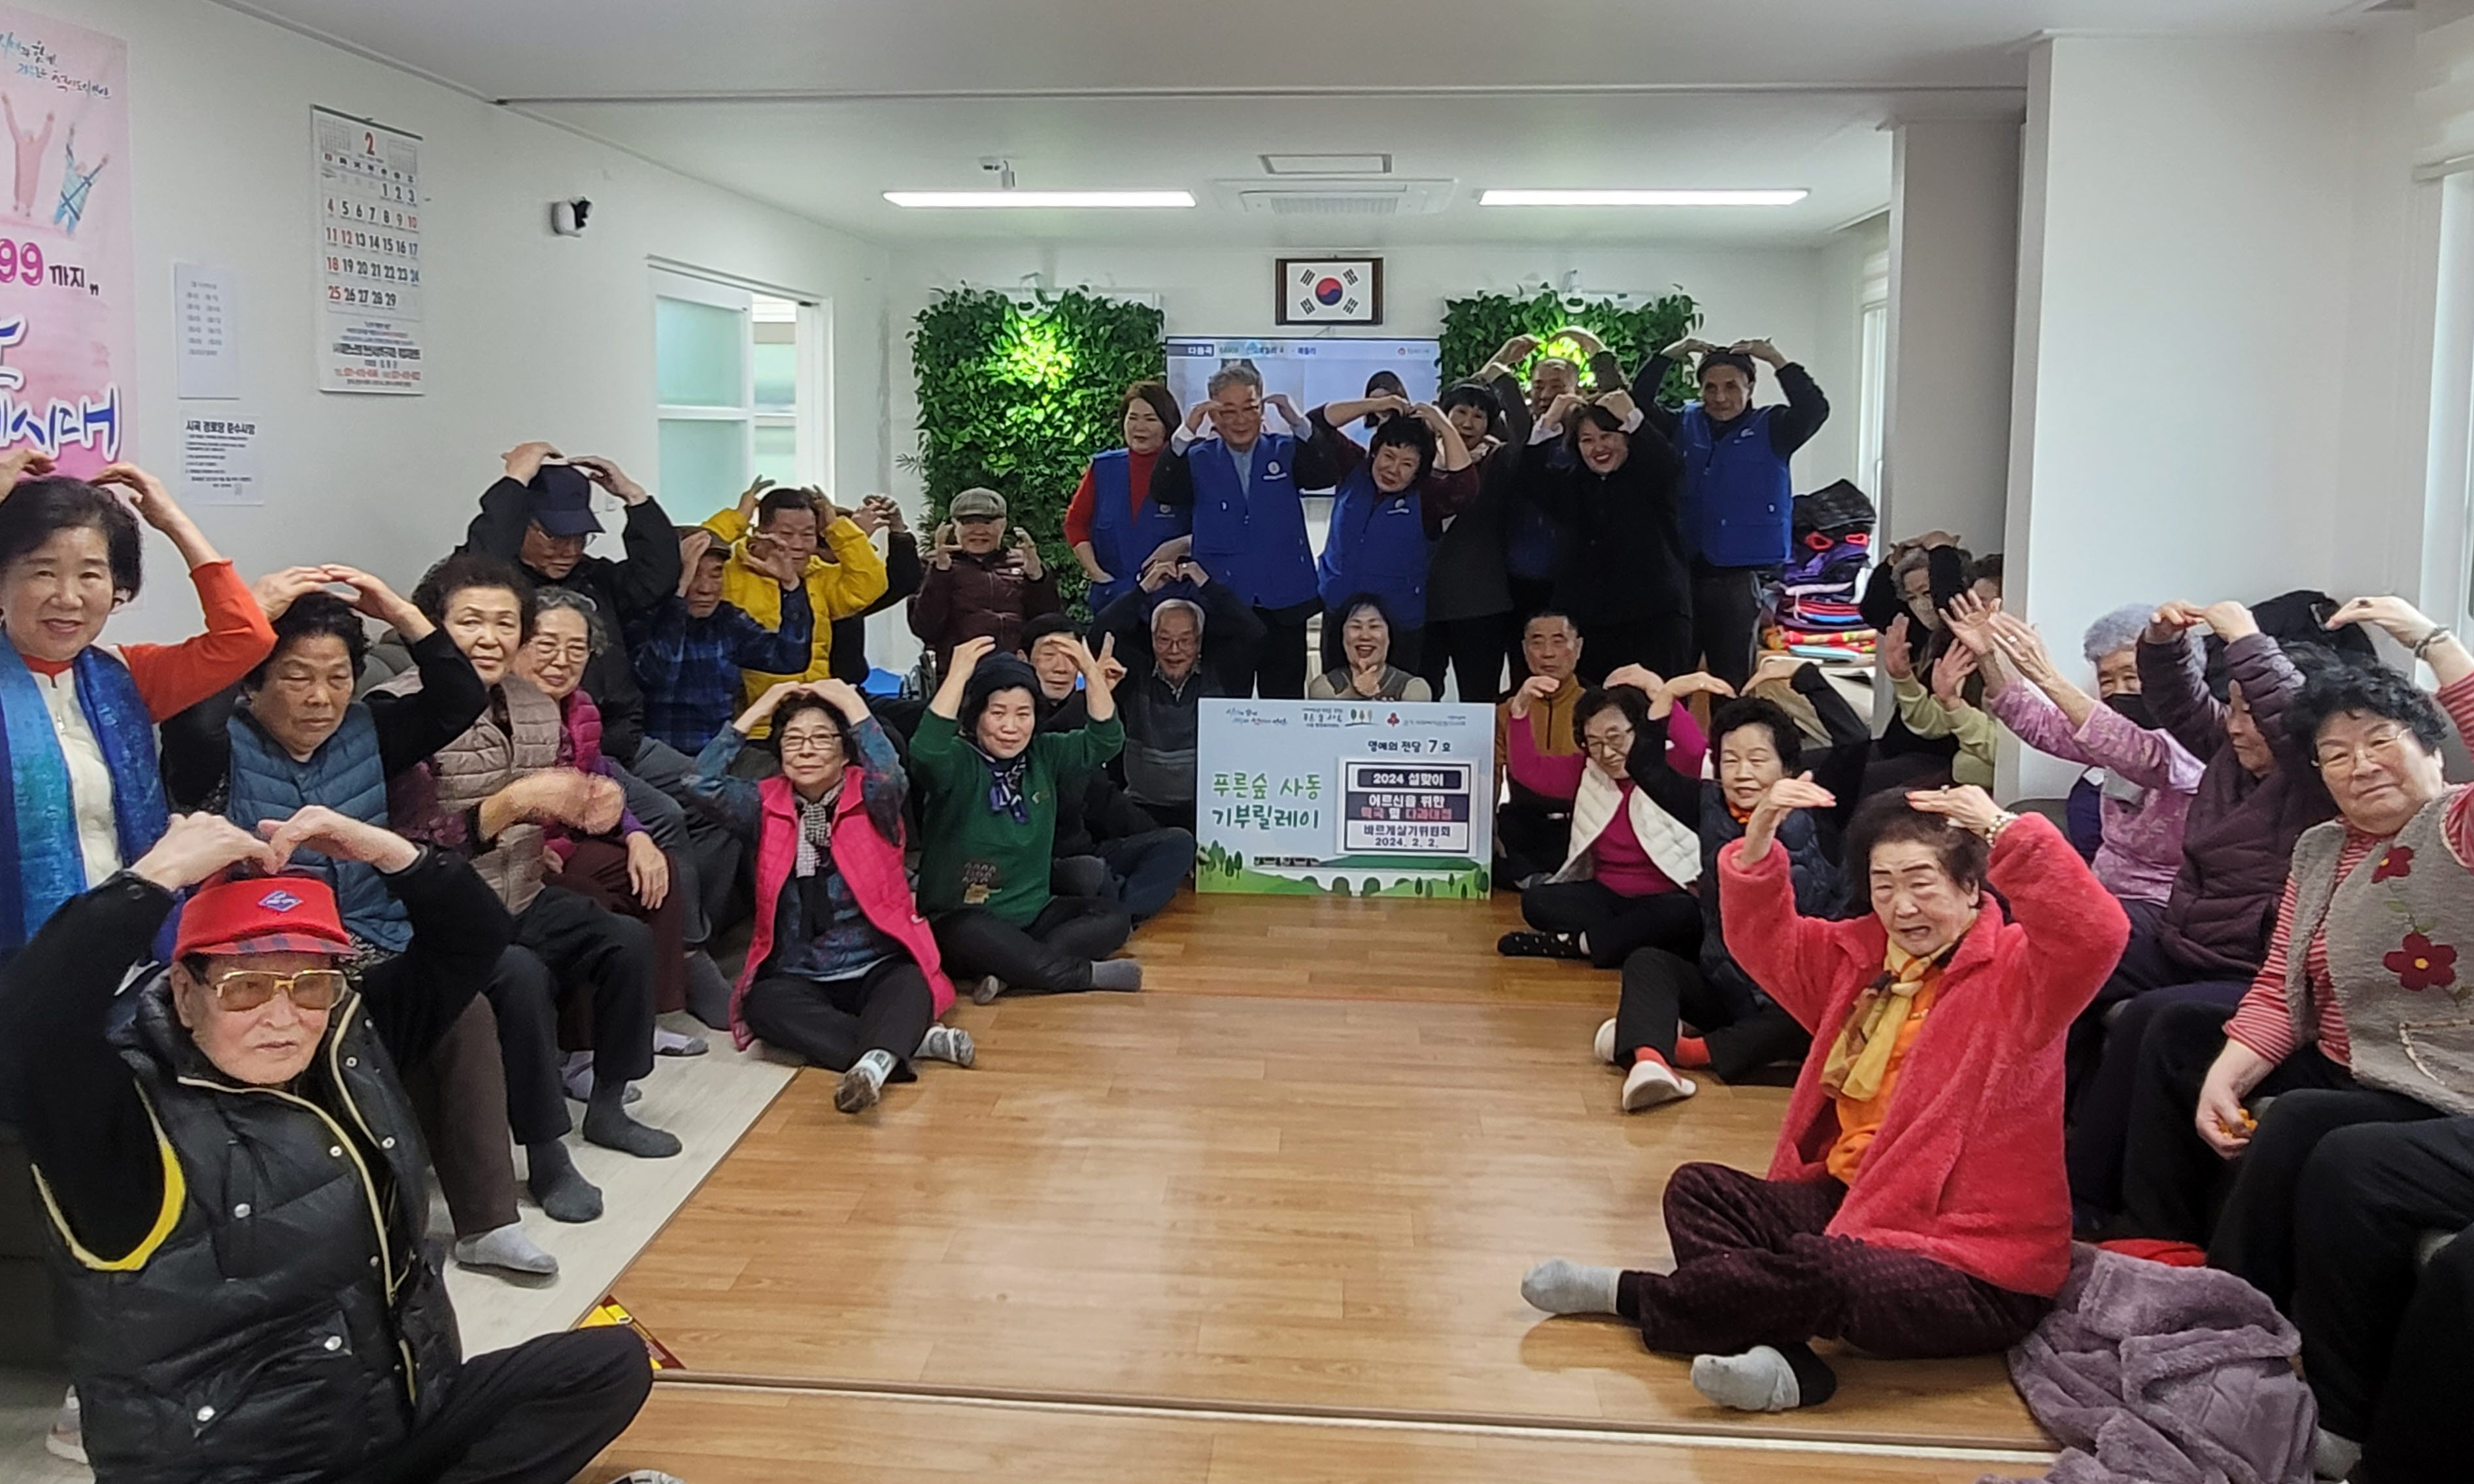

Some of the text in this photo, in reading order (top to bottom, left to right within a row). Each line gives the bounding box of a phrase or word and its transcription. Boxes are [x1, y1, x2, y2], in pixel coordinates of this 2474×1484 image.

[365, 131, 375, 156] 2
[382, 183, 415, 202] 1 2 3
[328, 198, 333, 212] 4
[343, 201, 348, 215] 5
[356, 204, 362, 218] 6
[369, 207, 375, 220] 7
[384, 210, 389, 224] 8
[397, 213, 402, 226] 9
[326, 227, 417, 256] 11 12 13 14 15 16 17
[327, 256, 339, 271] 18
[343, 258, 354, 273] 19
[357, 261, 368, 275] 20
[371, 263, 381, 277] 21
[384, 265, 395, 279] 22
[398, 267, 407, 281] 23
[328, 285, 396, 307] 25 26 27 28 29
[1401, 741, 1421, 752] 전당
[1428, 739, 1438, 752] 7
[1442, 742, 1451, 752] 호
[1213, 772, 1322, 800] 푸른숲 사동
[1373, 773, 1444, 786] 2024 설맞이
[1368, 794, 1445, 809] 어르신을 위한
[1212, 804, 1319, 830] 기부릴레이
[1364, 824, 1451, 837] 바르게살기위원회
[1375, 837, 1407, 847] 2024.
